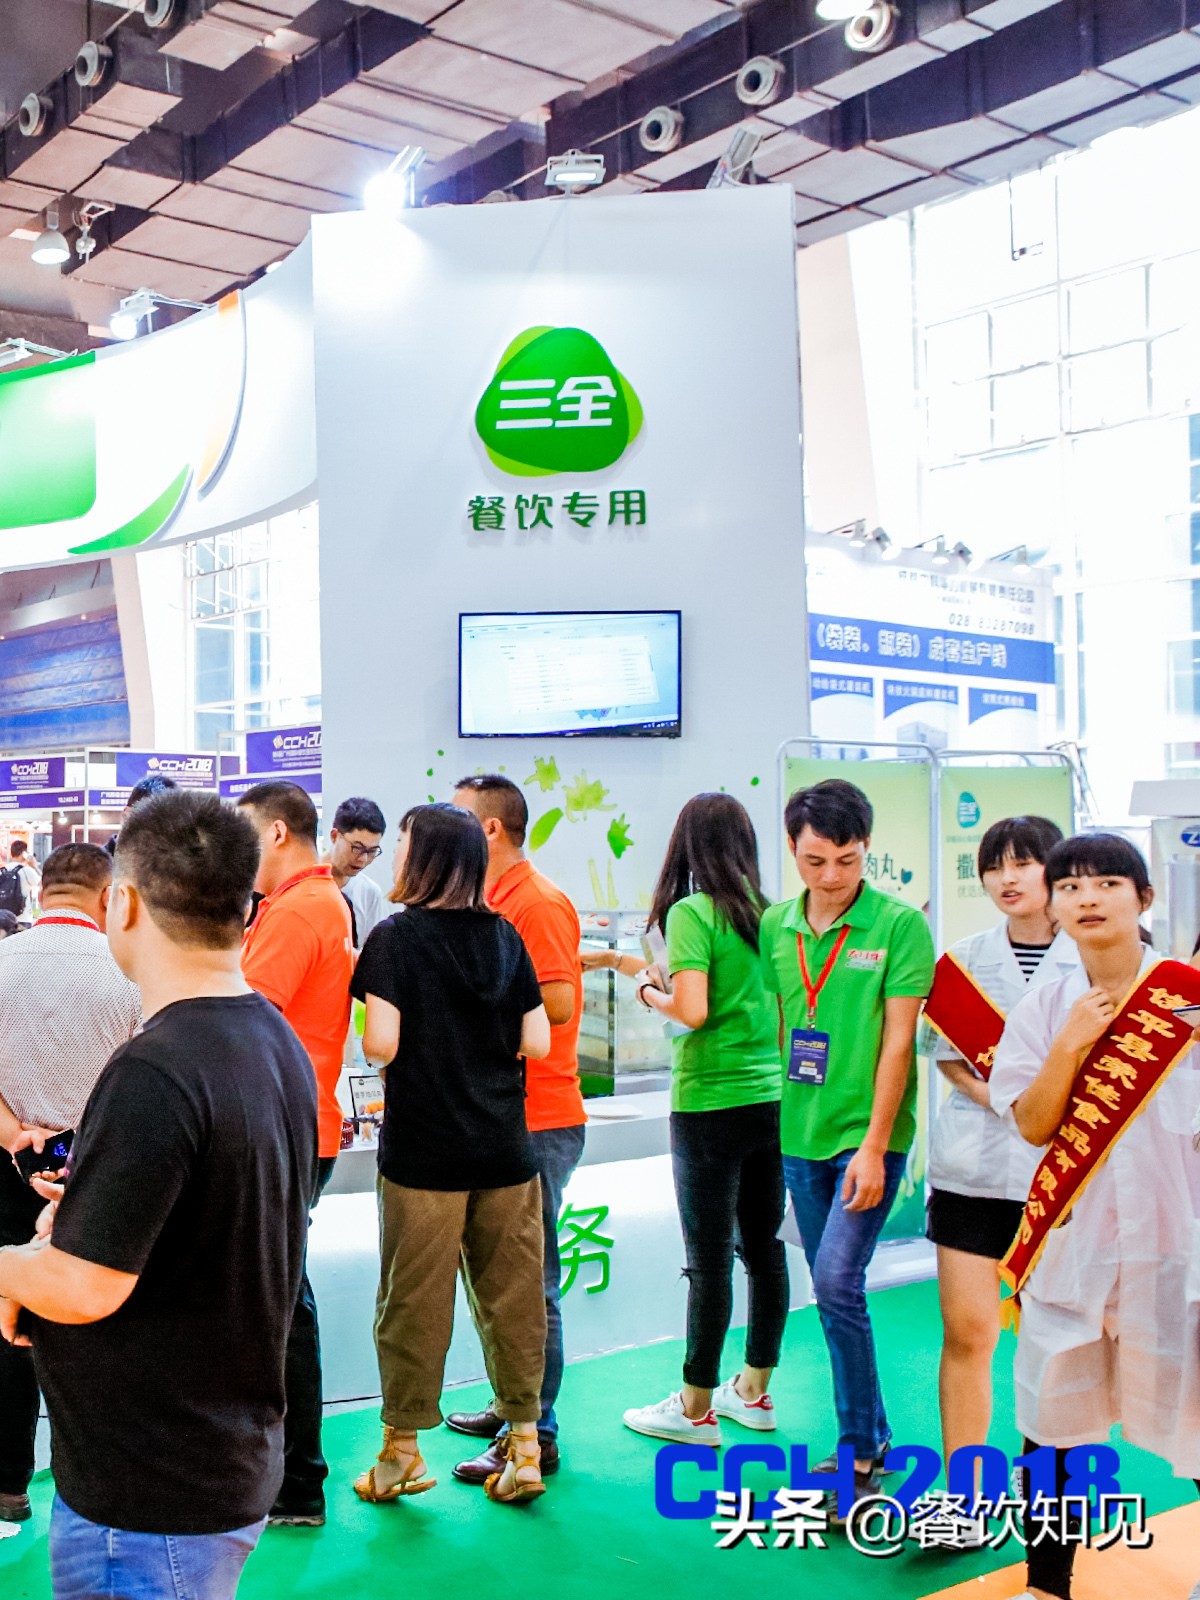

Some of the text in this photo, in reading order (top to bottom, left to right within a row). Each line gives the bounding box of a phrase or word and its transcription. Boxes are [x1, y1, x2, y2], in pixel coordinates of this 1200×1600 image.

[495, 375, 618, 430] 三全
[467, 490, 647, 532] 餐饮专用
